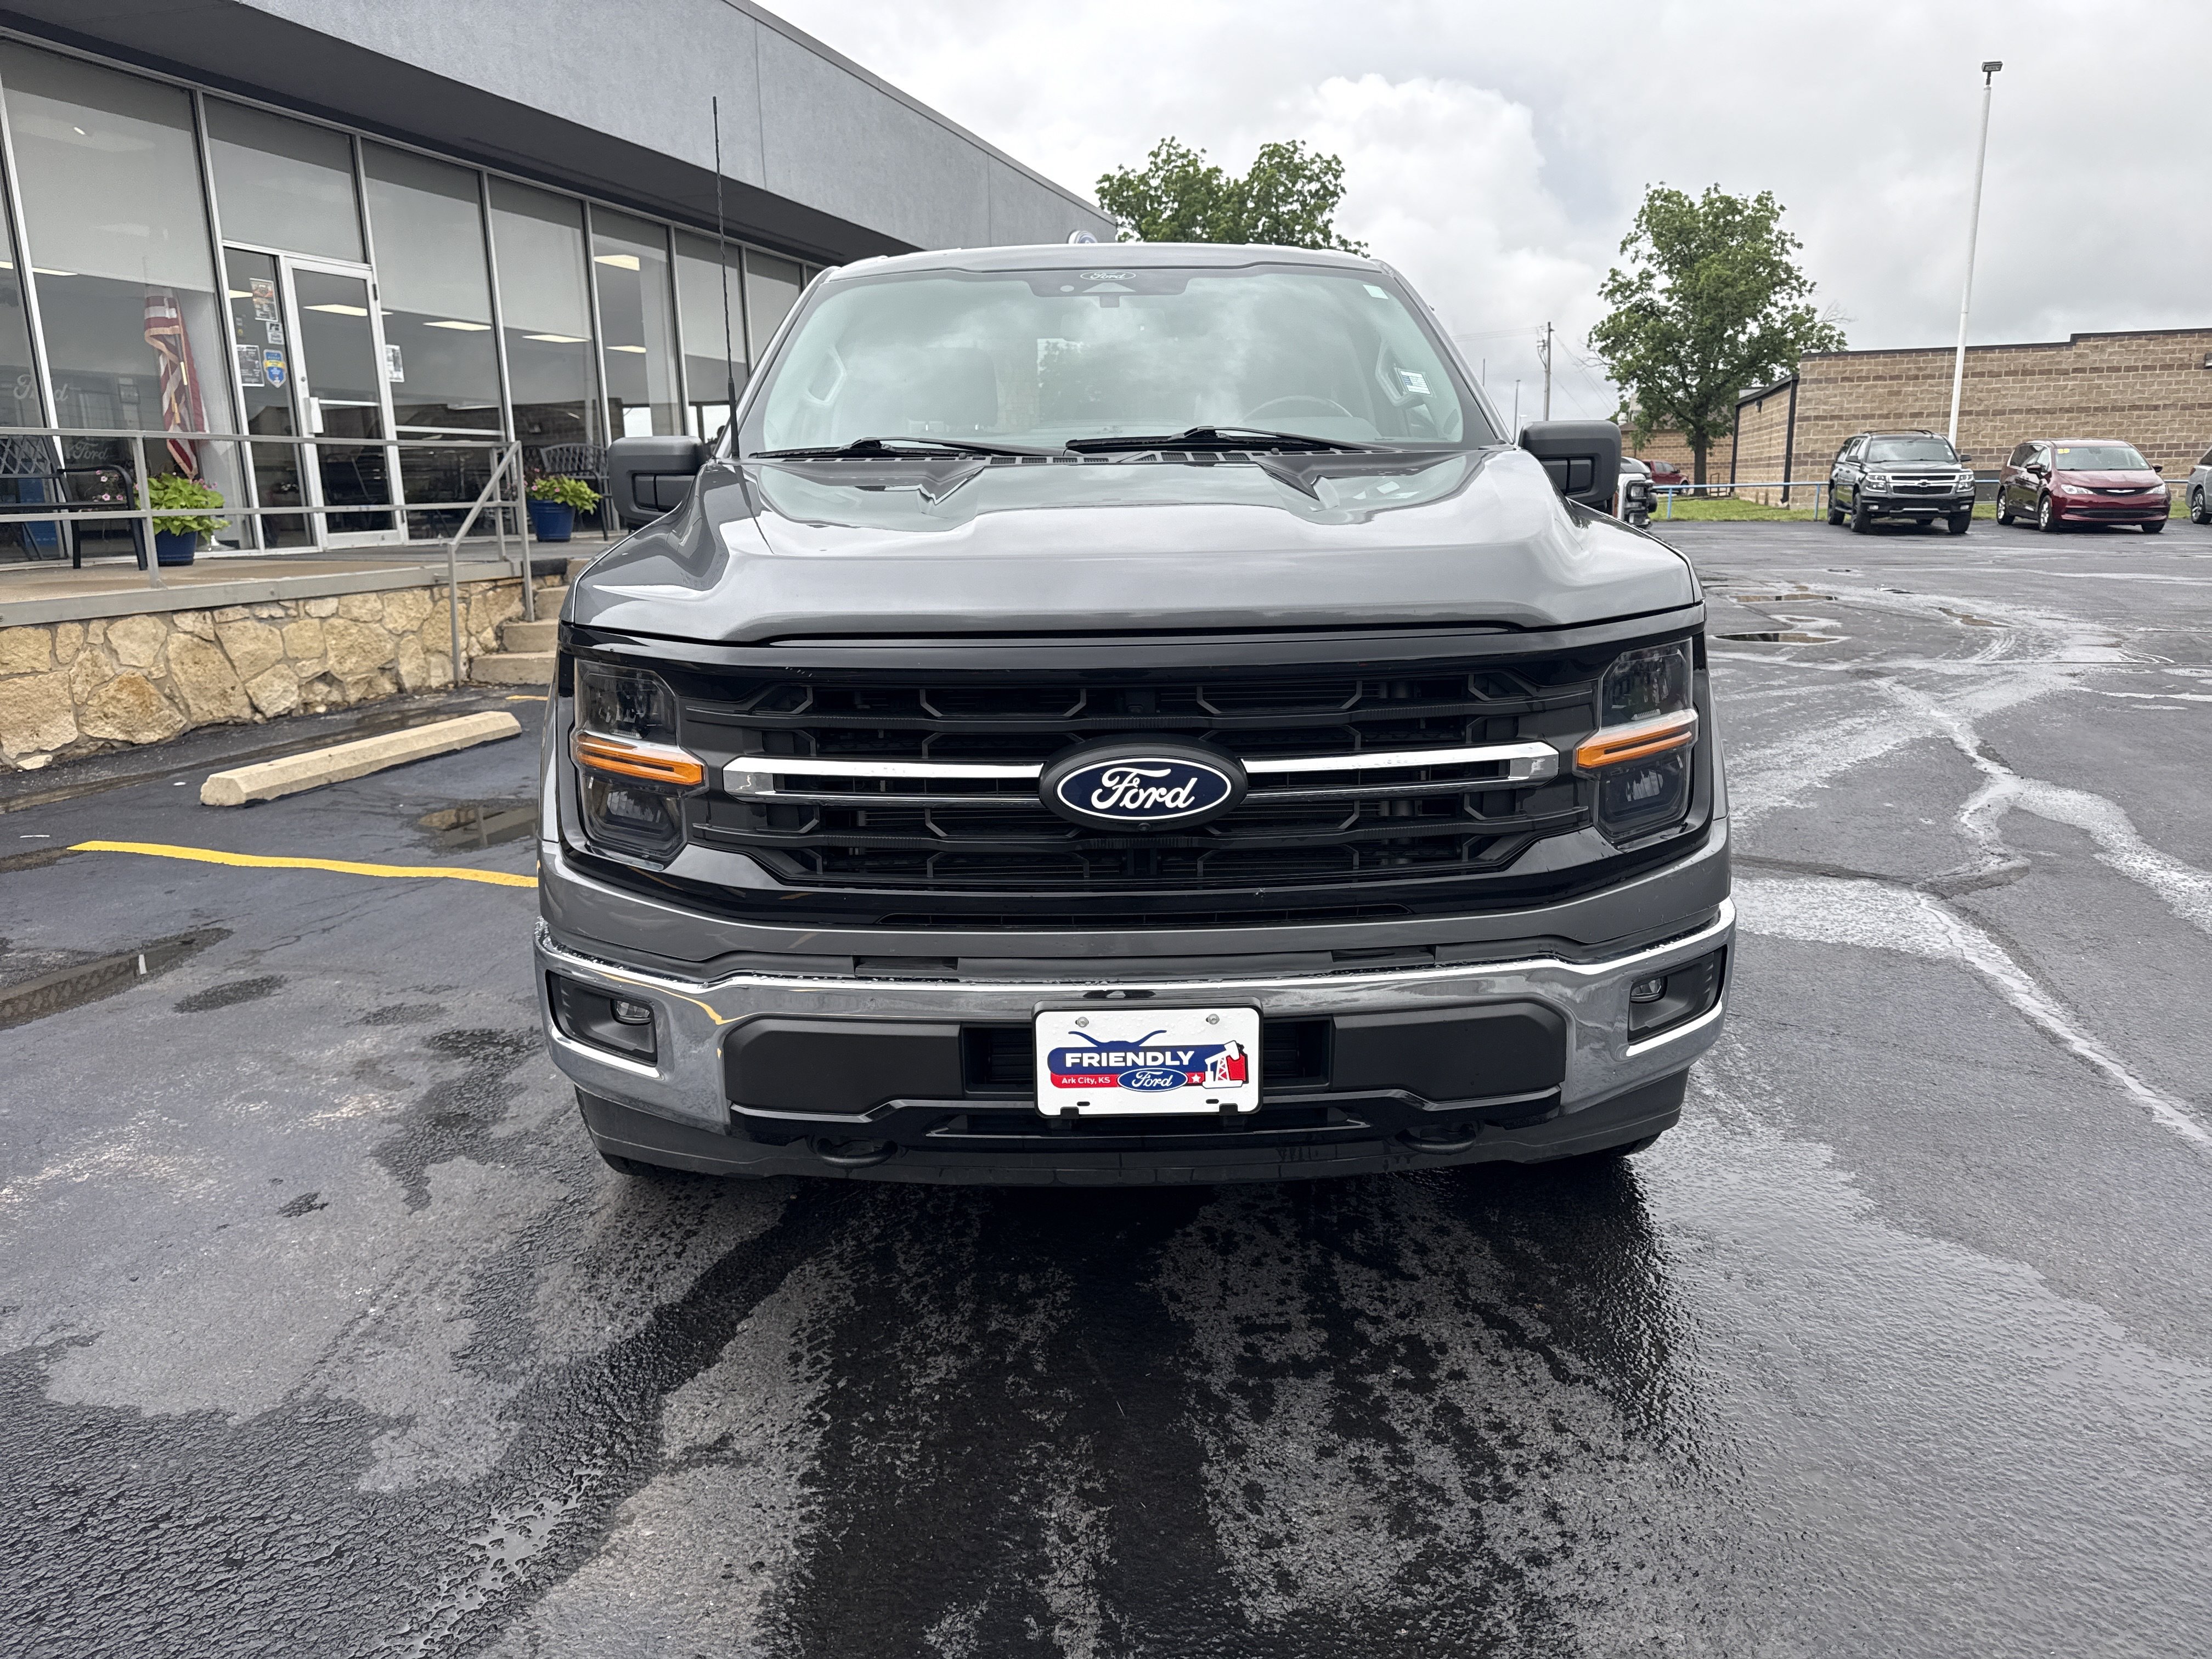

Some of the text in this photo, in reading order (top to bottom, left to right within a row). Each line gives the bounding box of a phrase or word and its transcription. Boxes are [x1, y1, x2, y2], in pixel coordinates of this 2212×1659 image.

[14, 374, 69, 400] Fd
[71, 441, 109, 460] Ford
[1091, 767, 1198, 809] Ford
[1065, 1051, 1194, 1068] FRIENDLY
[1077, 1077, 1097, 1086] City,
[1131, 1071, 1173, 1087] Ford
